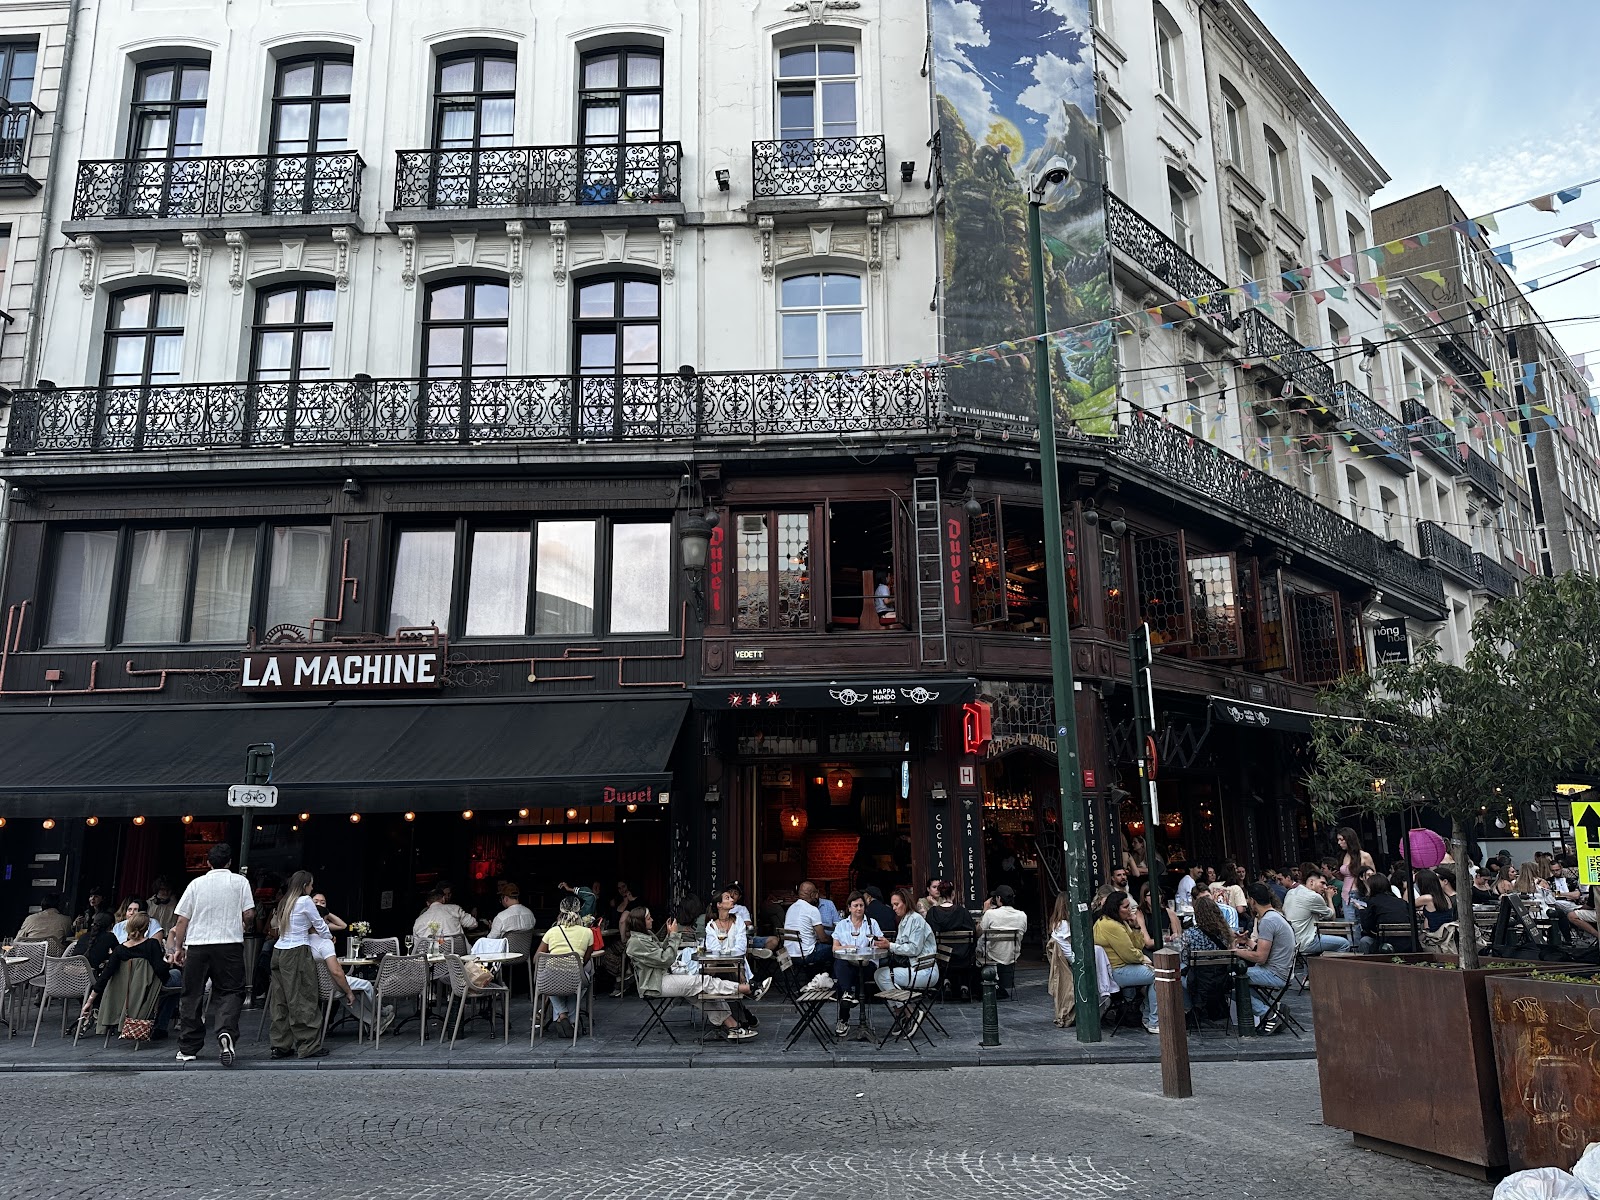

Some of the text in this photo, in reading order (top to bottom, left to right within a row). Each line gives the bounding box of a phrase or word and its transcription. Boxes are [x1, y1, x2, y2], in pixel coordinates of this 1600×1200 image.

[709, 526, 724, 611] Duvel
[948, 518, 962, 606] Duvel
[242, 653, 437, 687] LA MACHINE
[735, 650, 764, 659] VEDETT
[1028, 733, 1058, 754] MUND
[962, 769, 971, 782] H
[603, 785, 652, 803] Duvel
[1087, 799, 1095, 835] FIRST
[968, 846, 976, 901] SERVICE
